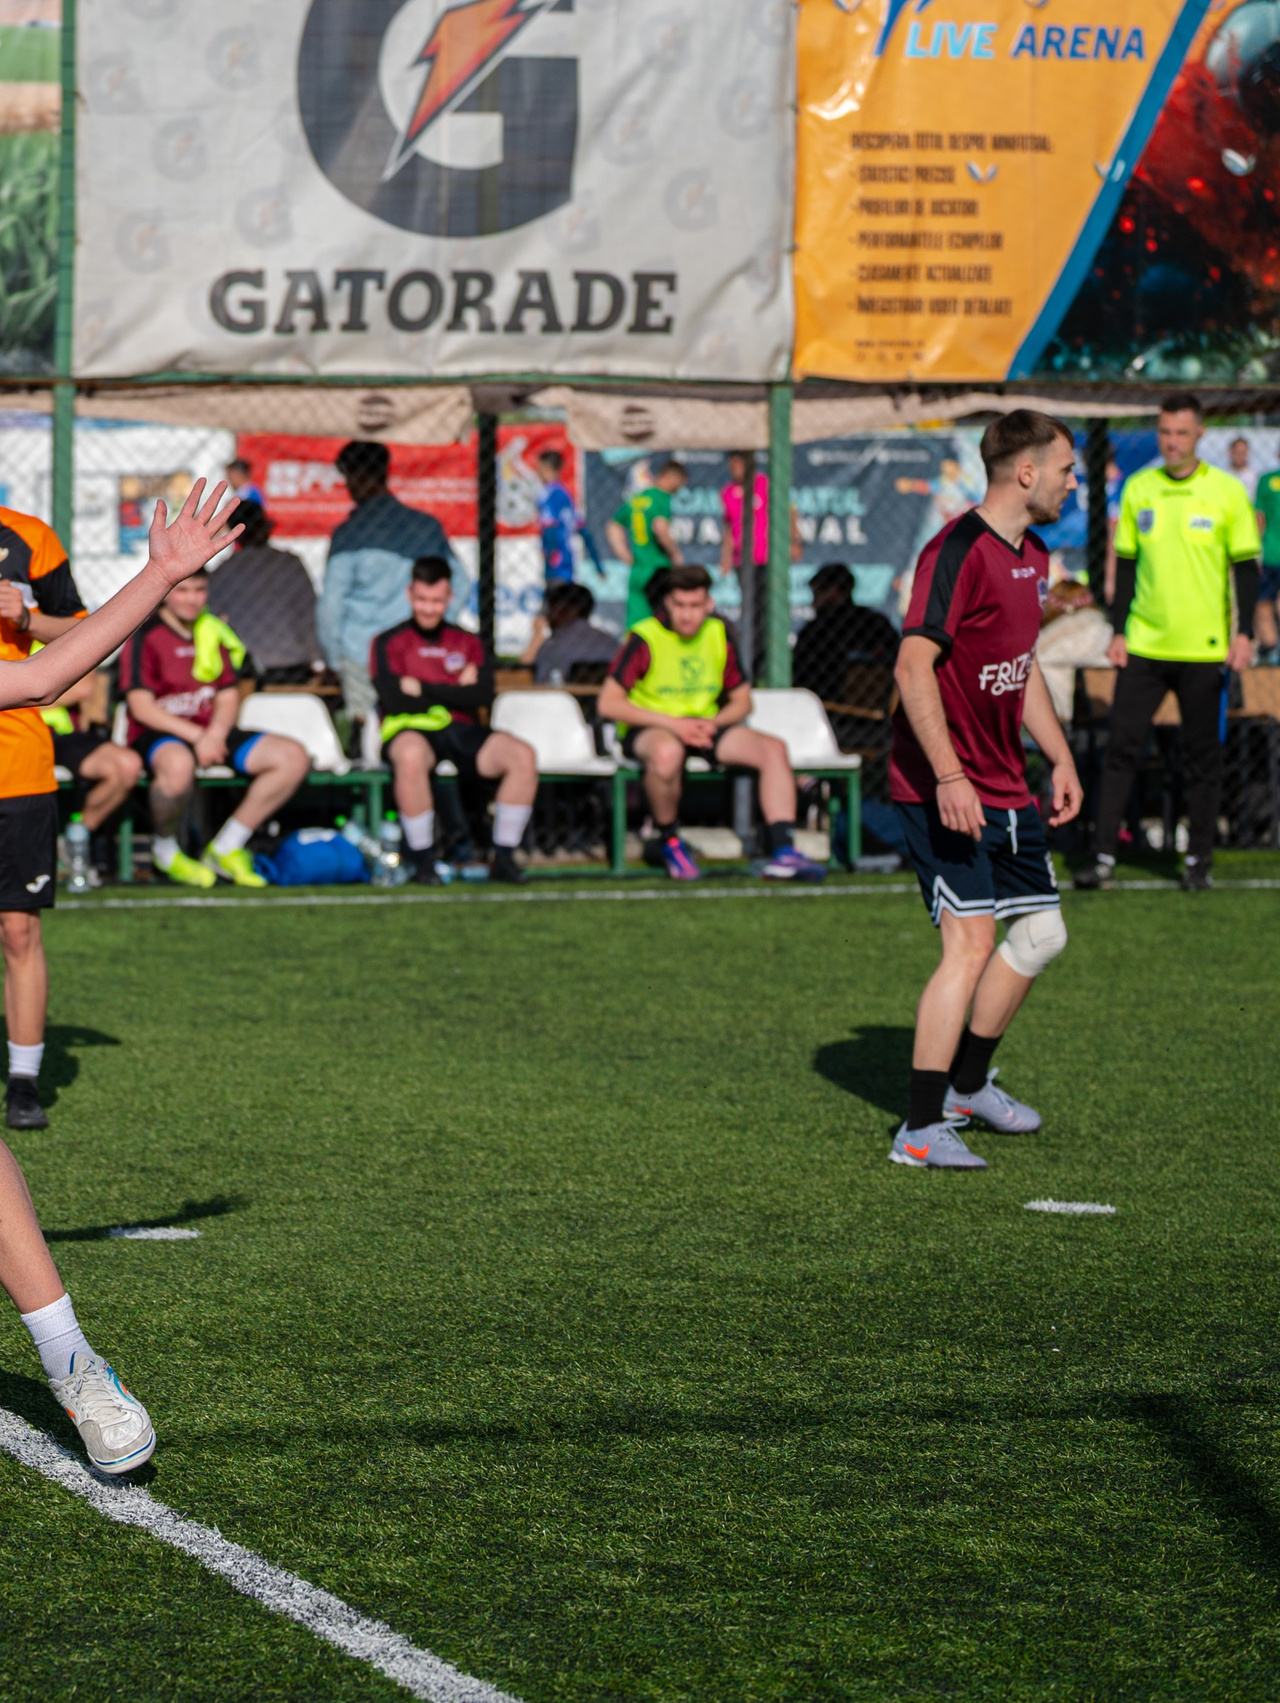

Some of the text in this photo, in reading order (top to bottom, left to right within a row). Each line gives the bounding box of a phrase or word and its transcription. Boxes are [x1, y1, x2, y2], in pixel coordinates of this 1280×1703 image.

[904, 22, 1146, 60] LIVE ARENA
[208, 269, 678, 335] GATORADE
